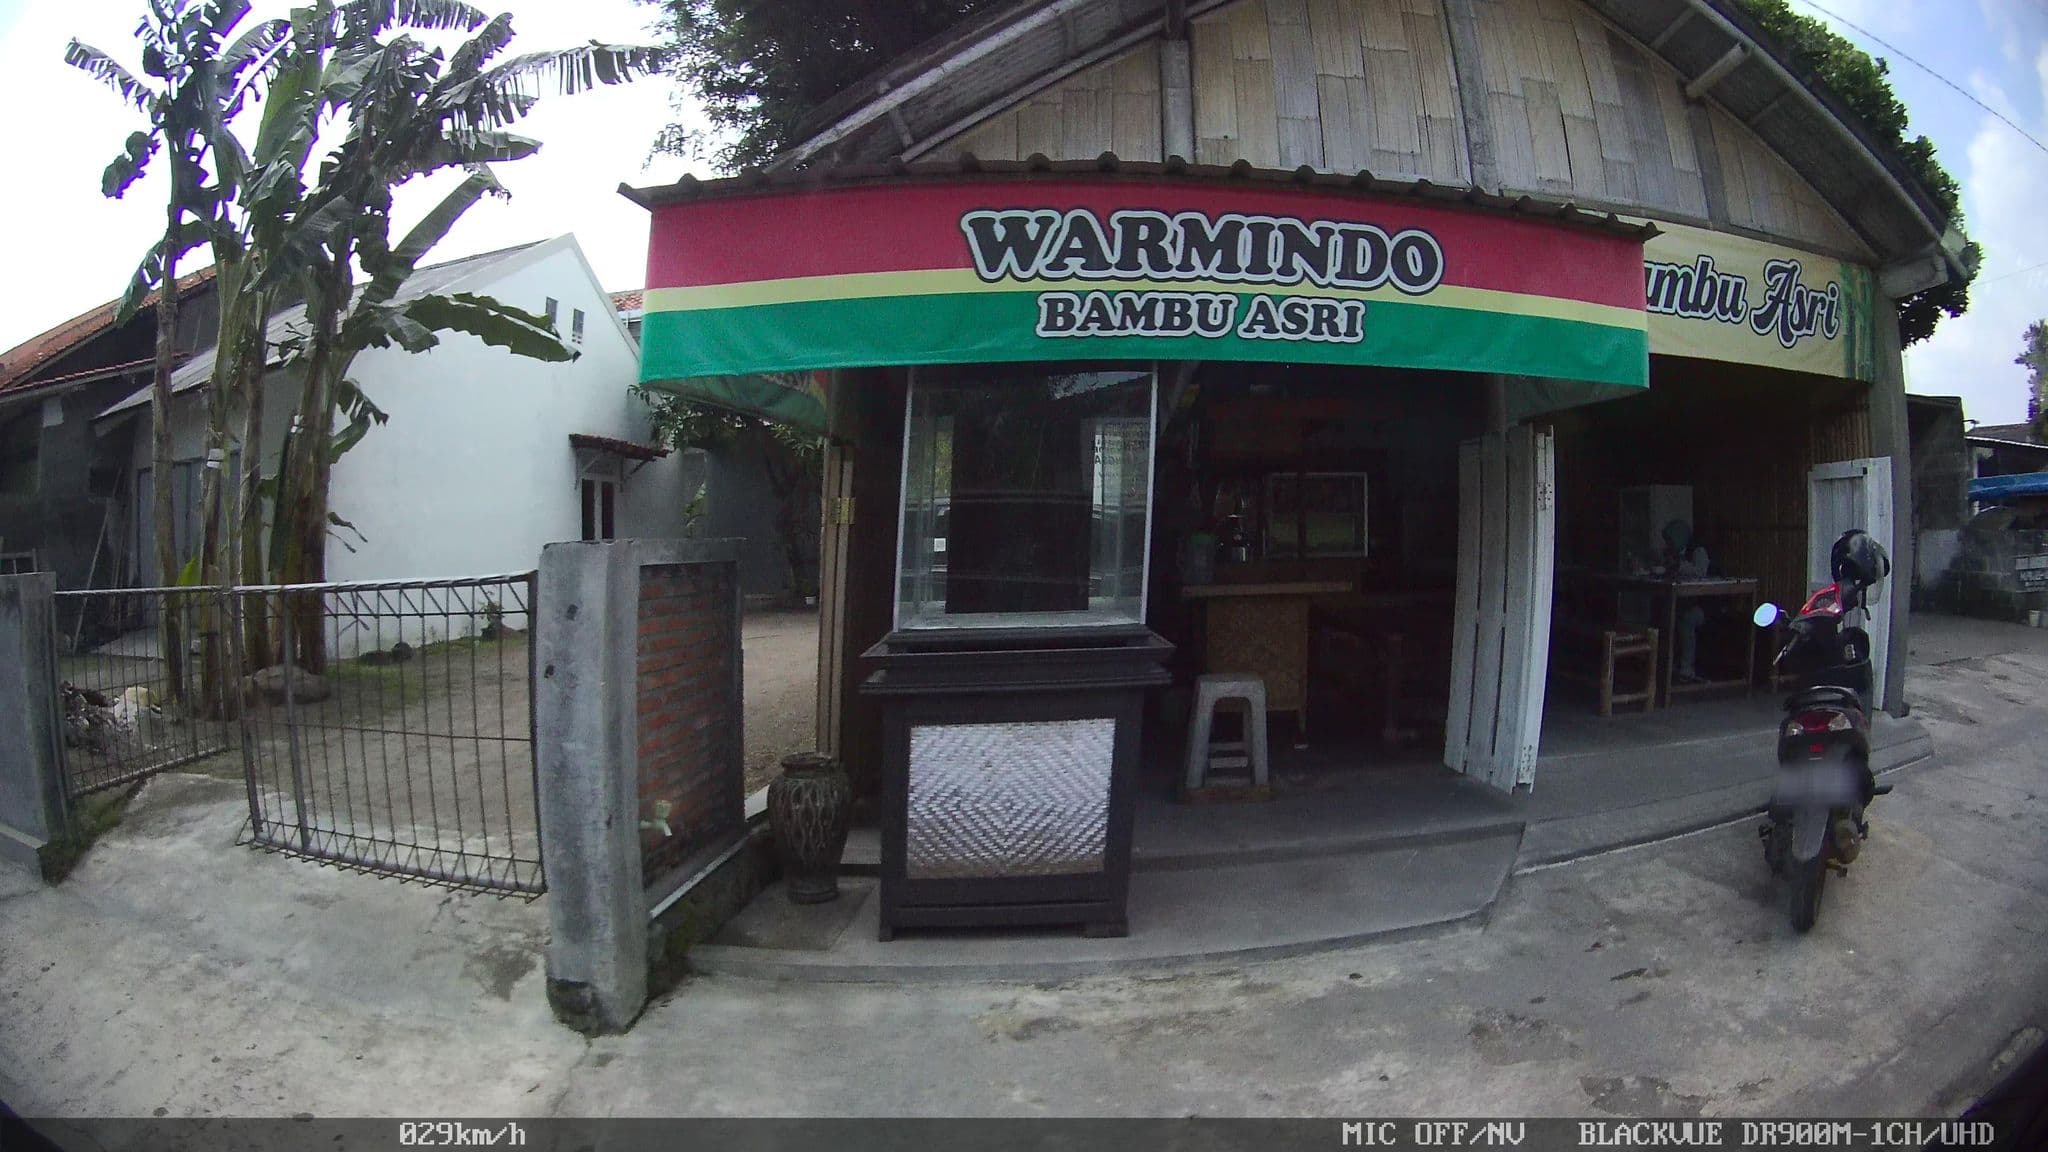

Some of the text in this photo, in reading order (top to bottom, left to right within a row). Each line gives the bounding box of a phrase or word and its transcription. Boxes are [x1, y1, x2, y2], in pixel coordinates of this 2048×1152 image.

[960, 207, 1444, 294] WARMINDO
[1034, 290, 1365, 343] BAMBU ASRI
[1750, 258, 1840, 348] Asri
